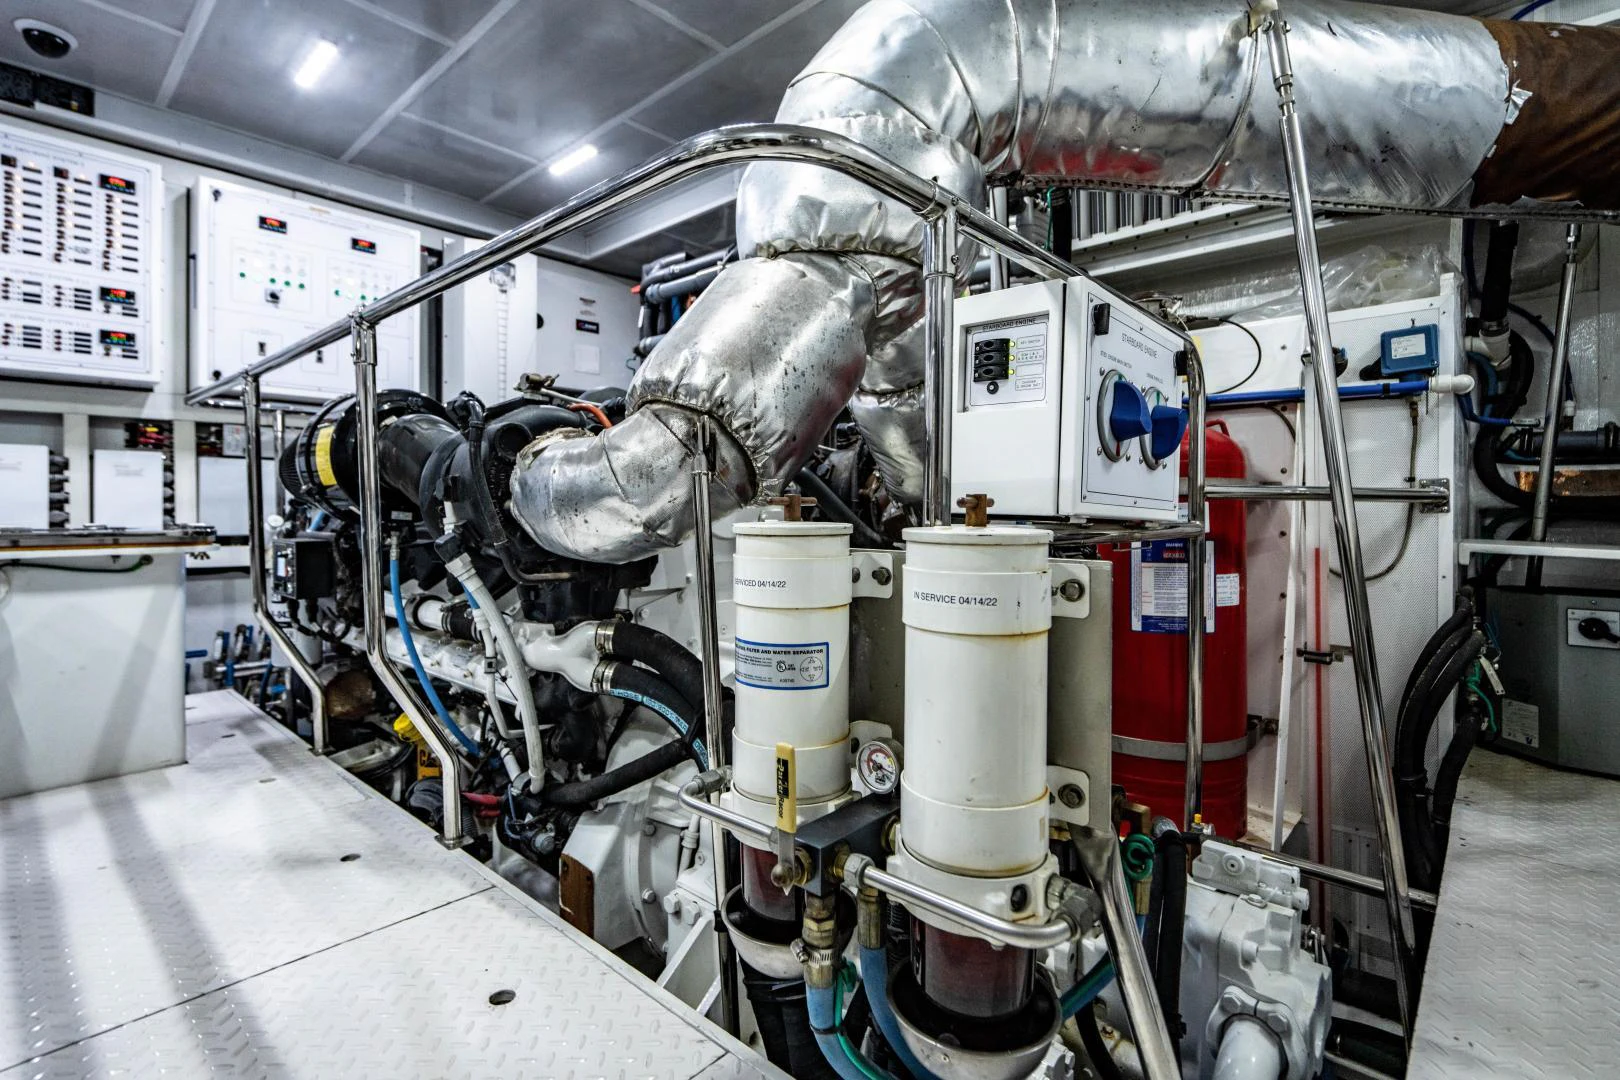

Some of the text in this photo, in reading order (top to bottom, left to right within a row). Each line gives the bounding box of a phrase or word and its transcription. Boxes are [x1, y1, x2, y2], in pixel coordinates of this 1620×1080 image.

[1016, 317, 1036, 326] ENGINE
[1121, 333, 1158, 359] STARBOARD ENGINE
[757, 580, 786, 588] 04/14/22
[913, 591, 998, 607] IN SERVICE 04/14/22
